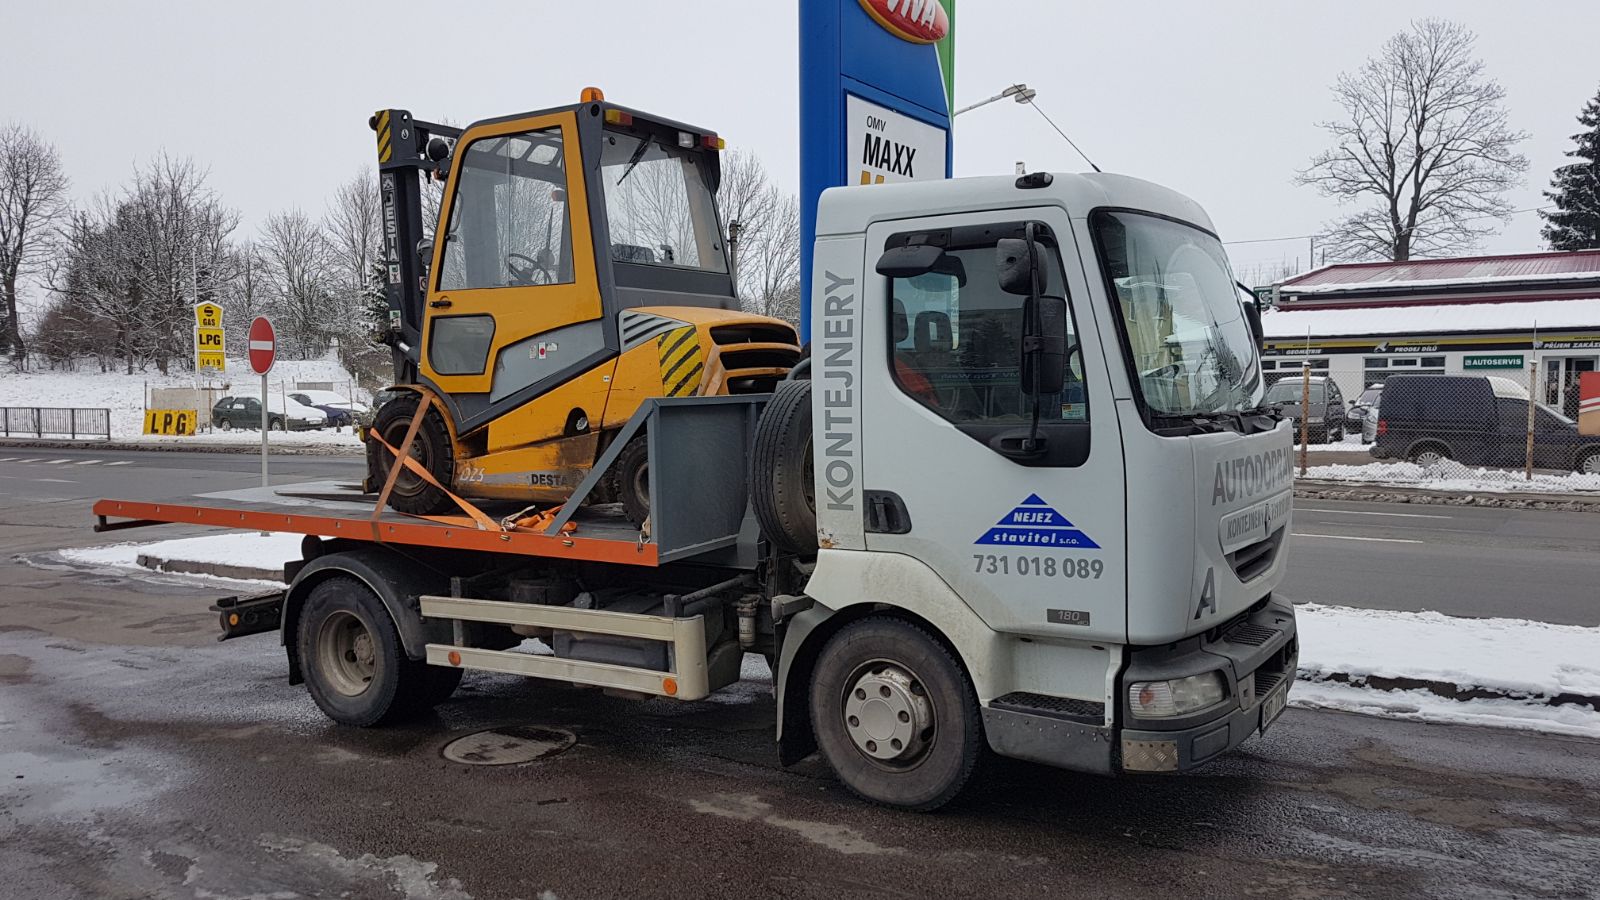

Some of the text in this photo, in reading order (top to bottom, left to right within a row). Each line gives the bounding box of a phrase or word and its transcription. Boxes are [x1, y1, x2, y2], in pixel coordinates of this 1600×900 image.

[866, 115, 887, 132] OMV
[862, 132, 917, 178] MAXX
[203, 318, 216, 326] GAS
[199, 334, 221, 345] LPG
[1472, 358, 1522, 366] AUTOSERVIS
[824, 270, 855, 511] KONTEJNERY
[150, 412, 187, 435] LPG
[531, 473, 569, 486] DESTA
[1013, 512, 1053, 523] NEJEZ
[993, 532, 1057, 543] stavitel
[973, 554, 1104, 579] 731 018 089
[1194, 567, 1216, 620] A
[1058, 610, 1080, 621] 180
